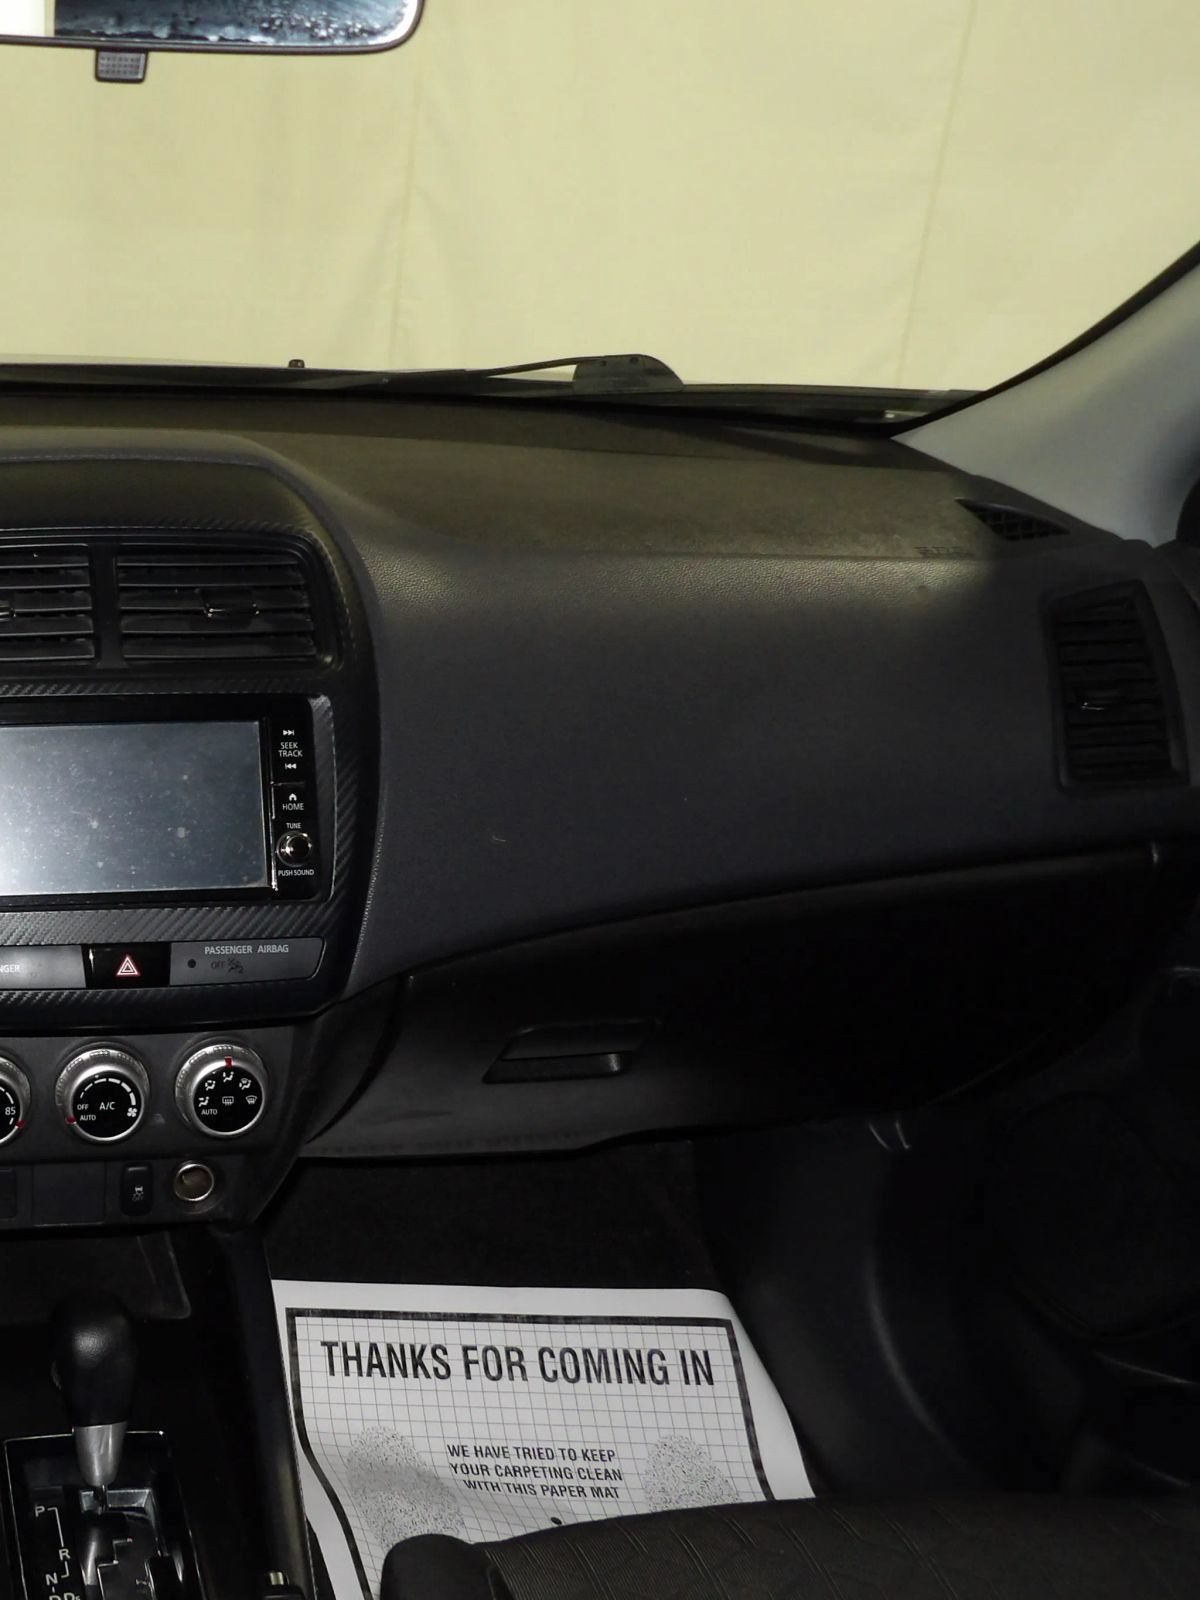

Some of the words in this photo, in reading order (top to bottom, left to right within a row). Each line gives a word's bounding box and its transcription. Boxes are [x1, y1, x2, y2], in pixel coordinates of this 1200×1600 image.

[278, 869, 293, 877] PUSH
[204, 945, 252, 955] PASSENGER
[257, 944, 289, 953] AIRBAG
[5, 1106, 16, 1115] 85
[99, 1101, 116, 1111] A/C
[320, 1341, 451, 1380] THANKS
[462, 1345, 528, 1381] FOR
[538, 1347, 670, 1385] COMING
[679, 1350, 714, 1386] IN
[447, 1444, 470, 1458] WE
[474, 1445, 510, 1459] HAVE
[514, 1446, 555, 1460] TRIED
[558, 1447, 577, 1461] TO
[582, 1448, 616, 1462] KEEP
[449, 1463, 490, 1477] YOUR
[494, 1464, 574, 1480] CARPETING
[578, 1467, 623, 1481] CLEAN
[463, 1479, 501, 1492] WITH
[504, 1482, 537, 1496] THIS
[541, 1484, 587, 1498] PAPER
[591, 1486, 619, 1499] MAT
[35, 1505, 45, 1517] P
[58, 1548, 71, 1560] R
[45, 1572, 58, 1586] N
